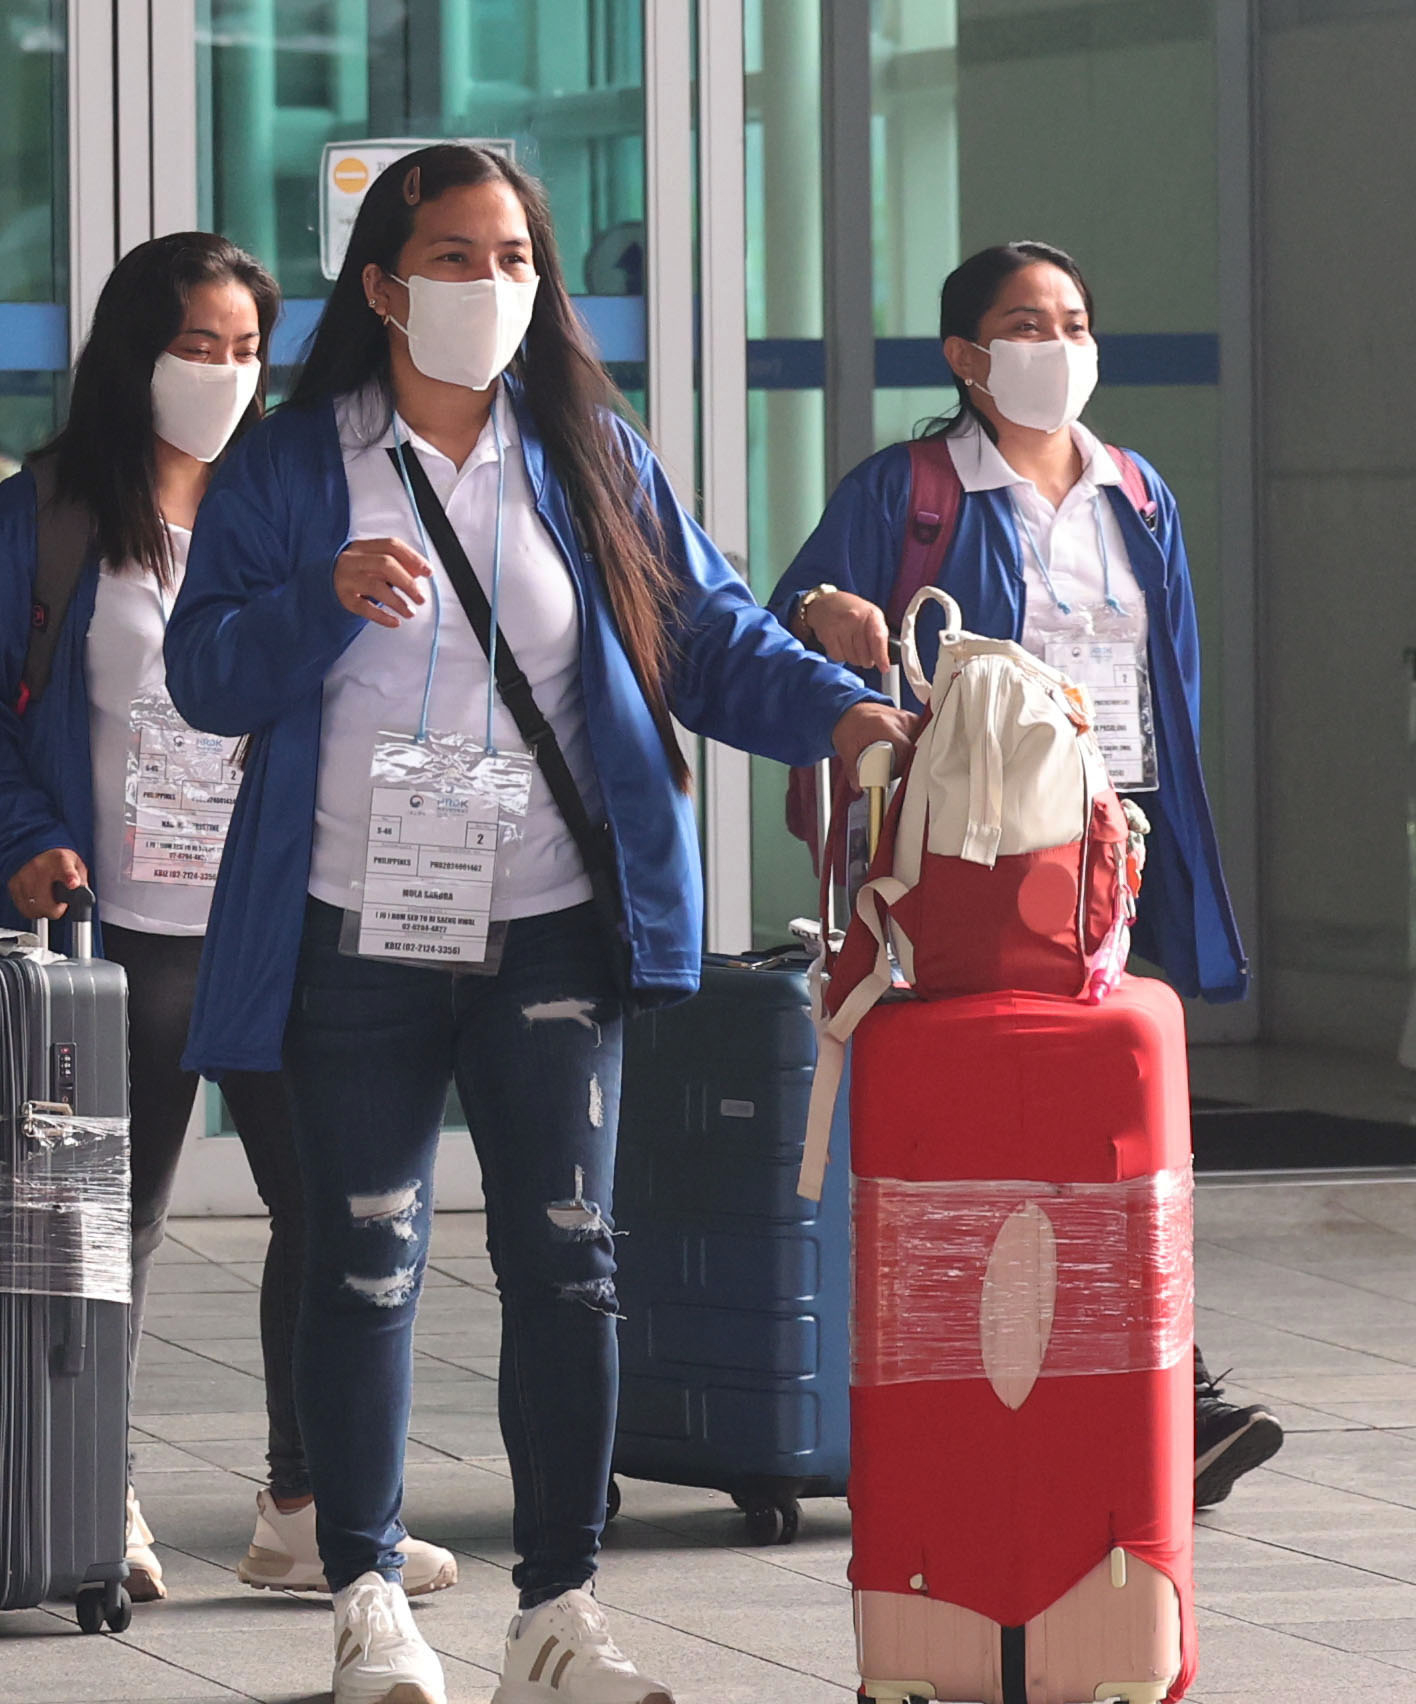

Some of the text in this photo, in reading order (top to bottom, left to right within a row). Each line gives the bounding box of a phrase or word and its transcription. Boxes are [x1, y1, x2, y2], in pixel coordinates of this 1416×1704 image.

[231, 770, 236, 780] 2
[477, 833, 484, 845] 2
[374, 856, 411, 866] PHILIPPINES
